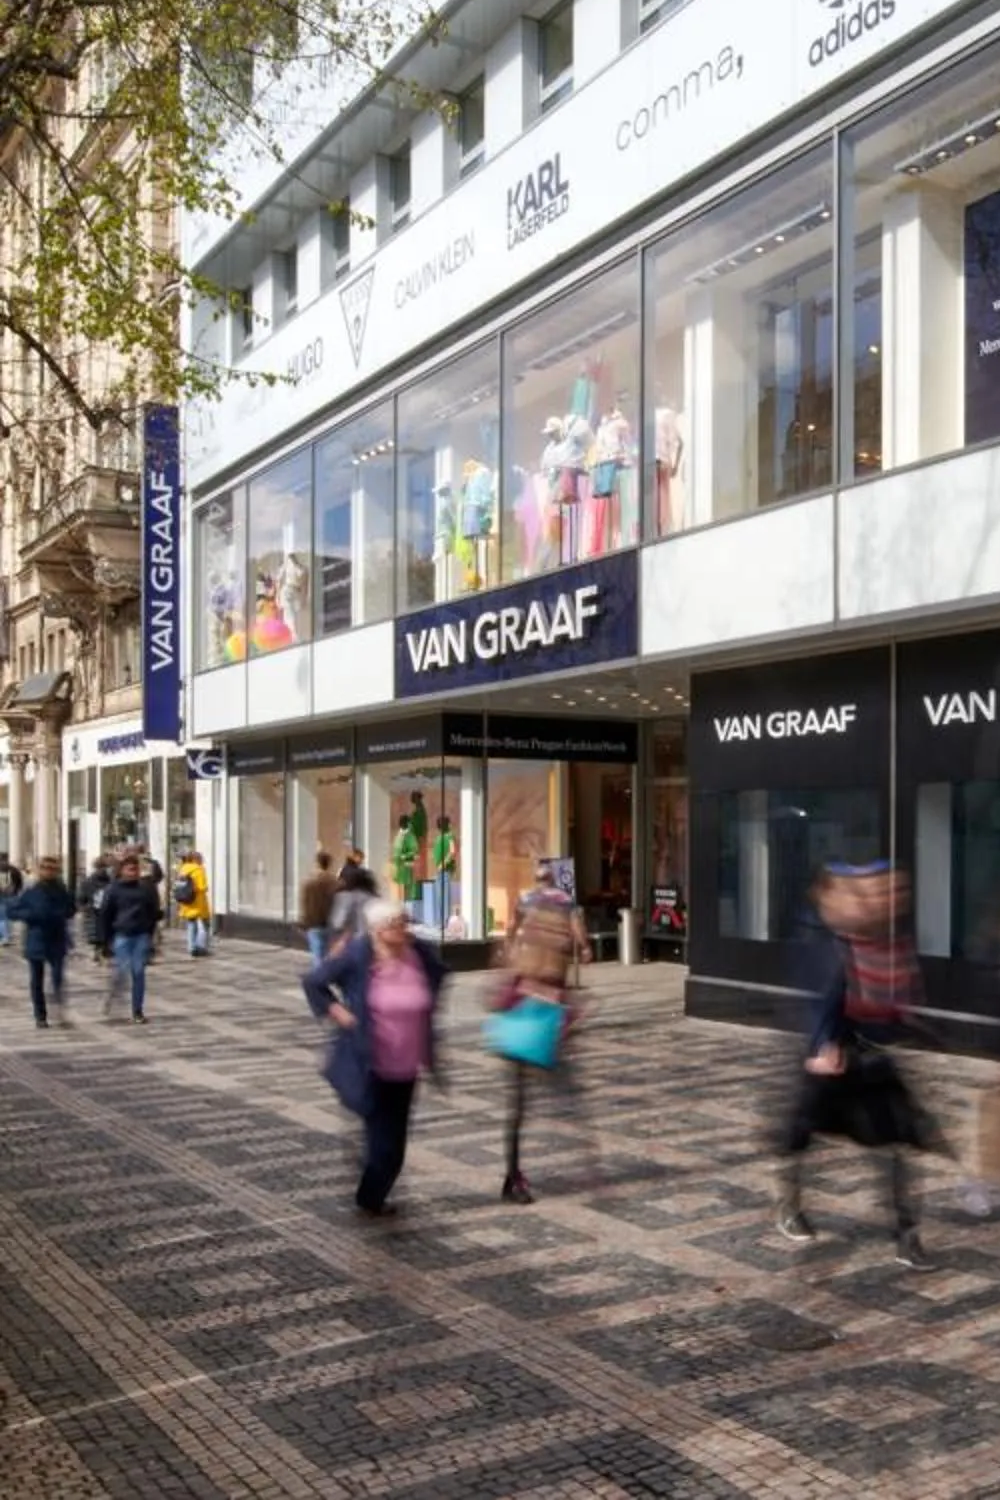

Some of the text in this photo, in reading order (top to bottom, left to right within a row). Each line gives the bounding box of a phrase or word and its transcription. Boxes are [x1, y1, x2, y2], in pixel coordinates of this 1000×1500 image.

[616, 44, 744, 151] comma,
[507, 152, 570, 229] KARL
[507, 194, 570, 251] LAGERFELD
[150, 471, 174, 671] VAN GRAAF
[405, 585, 601, 674] VAN GRAAF
[714, 704, 857, 742] VAN GRAAF
[924, 689, 996, 726] VAN
